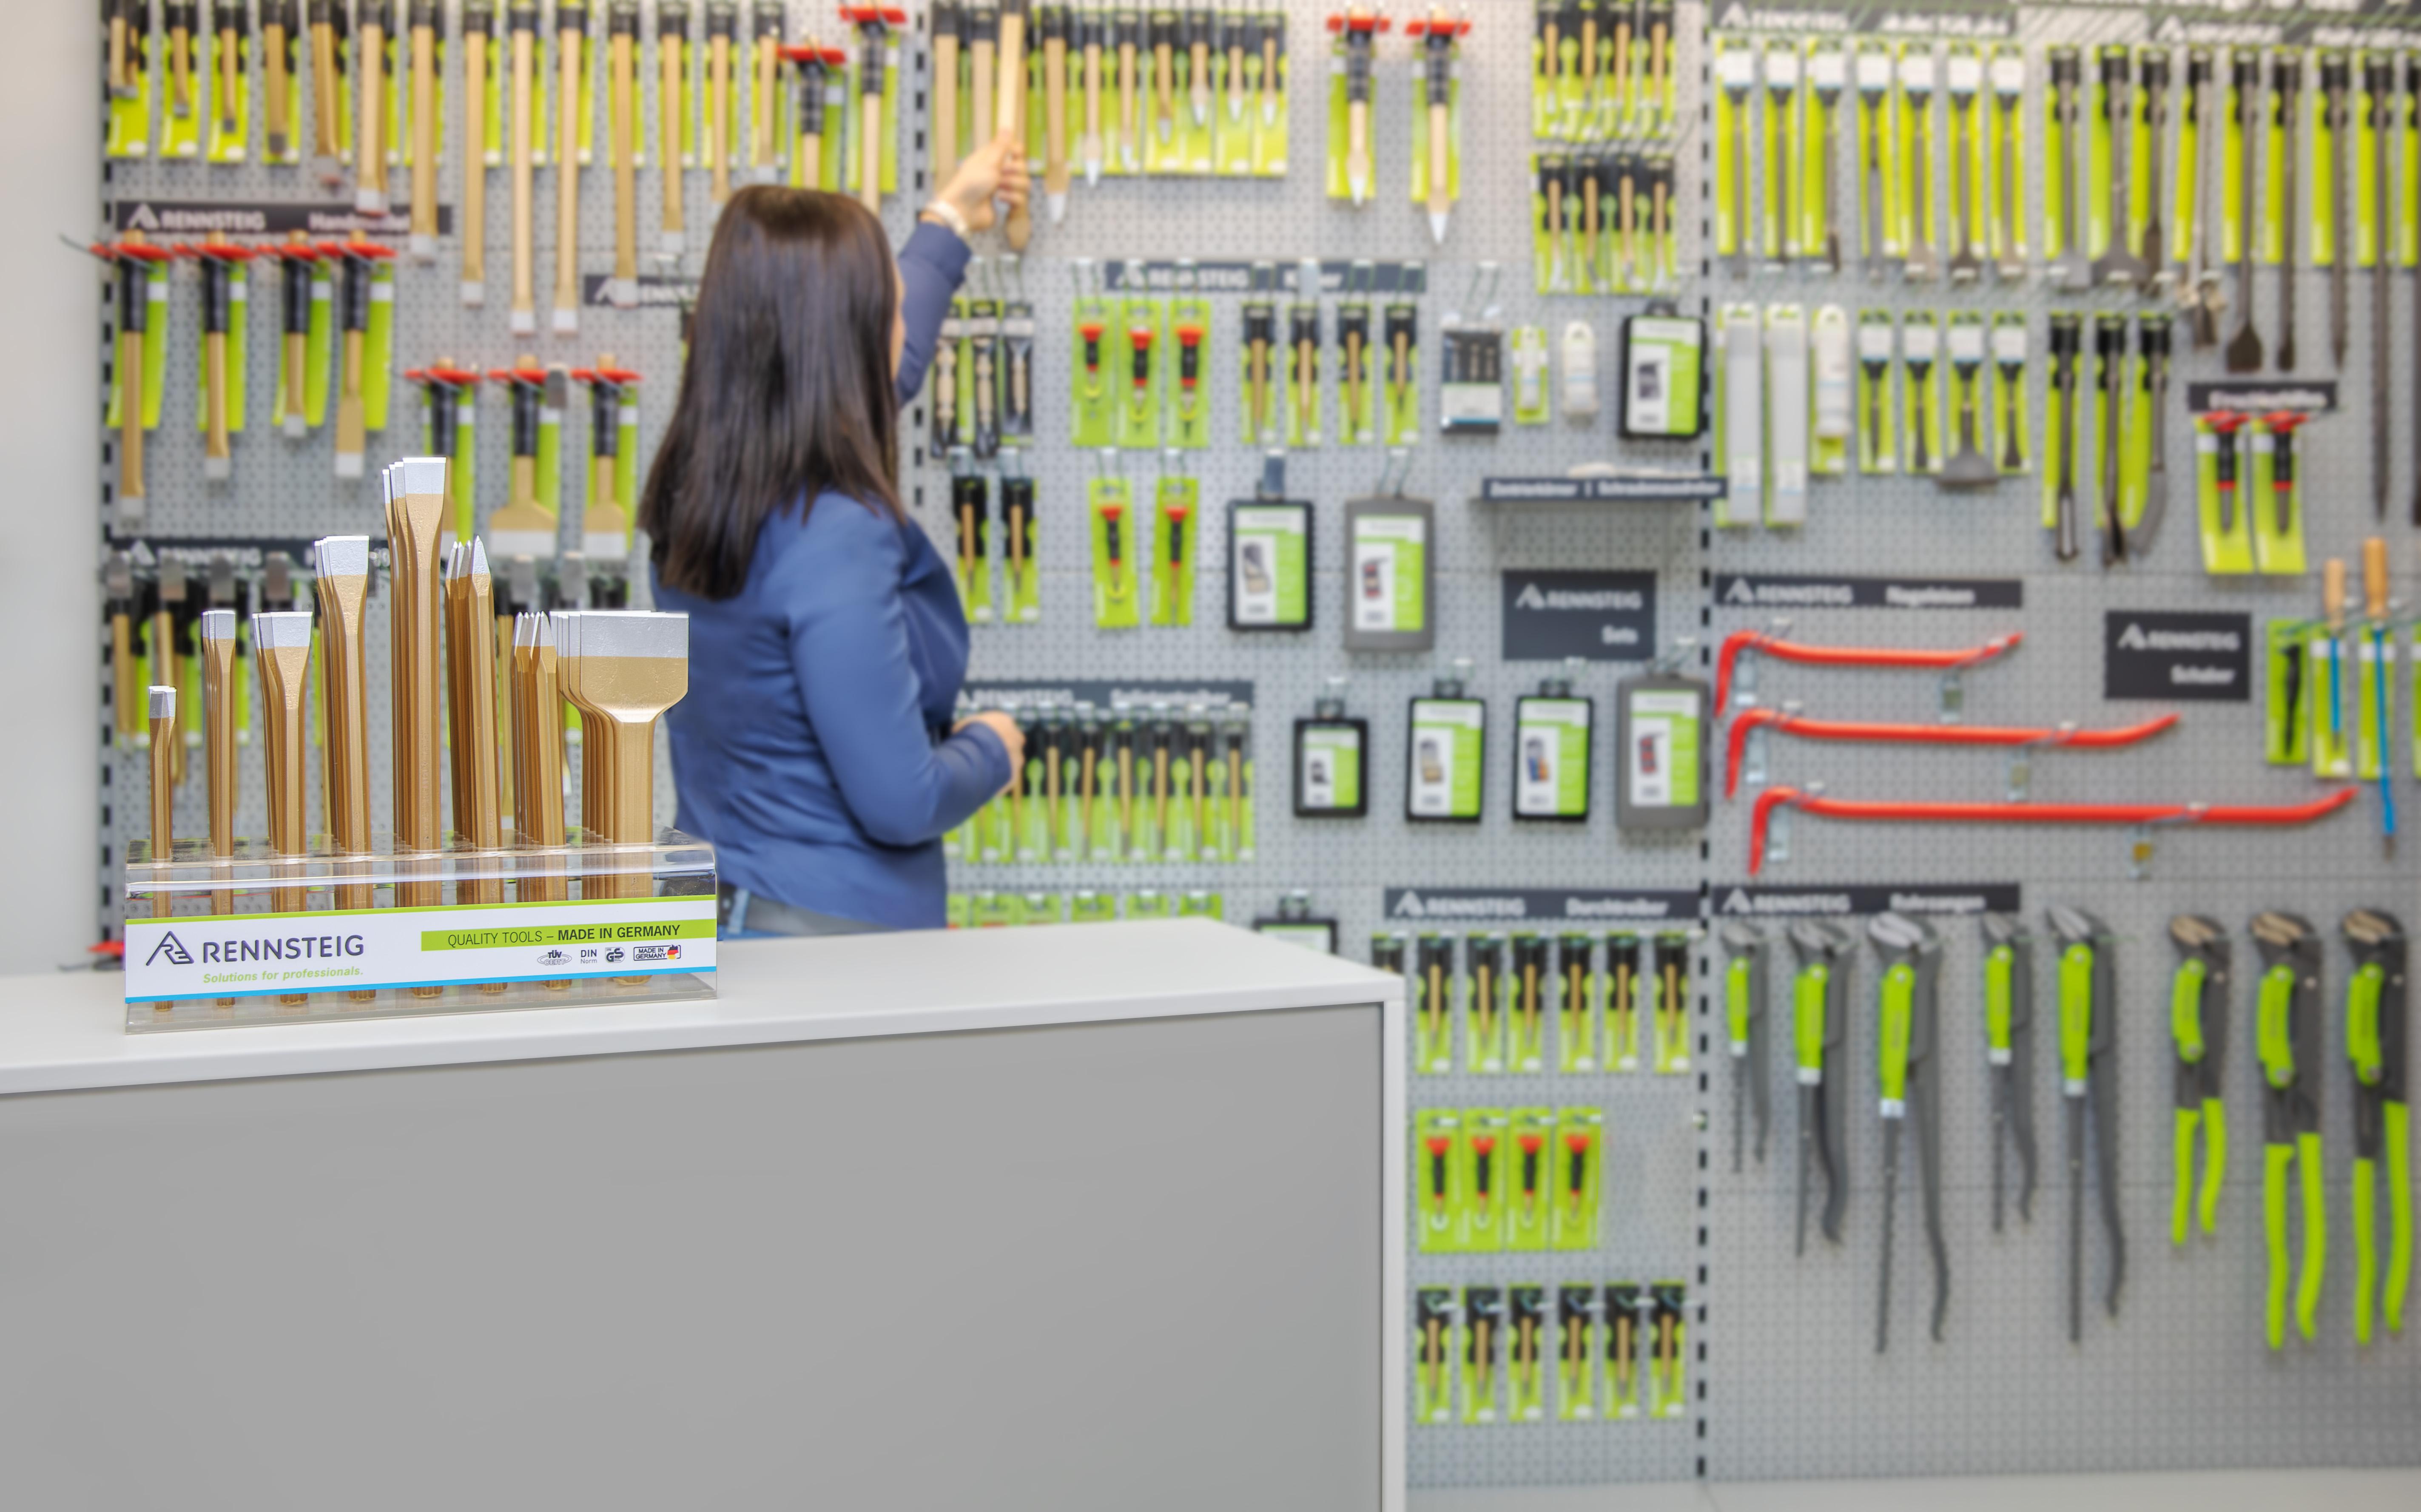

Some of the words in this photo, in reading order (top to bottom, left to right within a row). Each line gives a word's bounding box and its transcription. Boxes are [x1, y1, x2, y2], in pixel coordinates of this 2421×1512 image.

[1547, 591, 1643, 610] RENNSTEIG
[1425, 897, 1526, 916] RENNSTEIG
[1754, 895, 1851, 913] RENNSTEIG
[448, 932, 498, 947] QUALITY
[502, 930, 542, 944] TOOLS
[558, 928, 595, 941] MADE
[600, 927, 612, 939] IN
[617, 924, 680, 938] GERMANY
[203, 935, 364, 963] RENNSTEIG
[548, 949, 562, 958] TÜV
[581, 949, 597, 958] DIN
[203, 972, 257, 983] Solutions
[262, 970, 278, 980] for
[283, 966, 364, 981] professionals.
